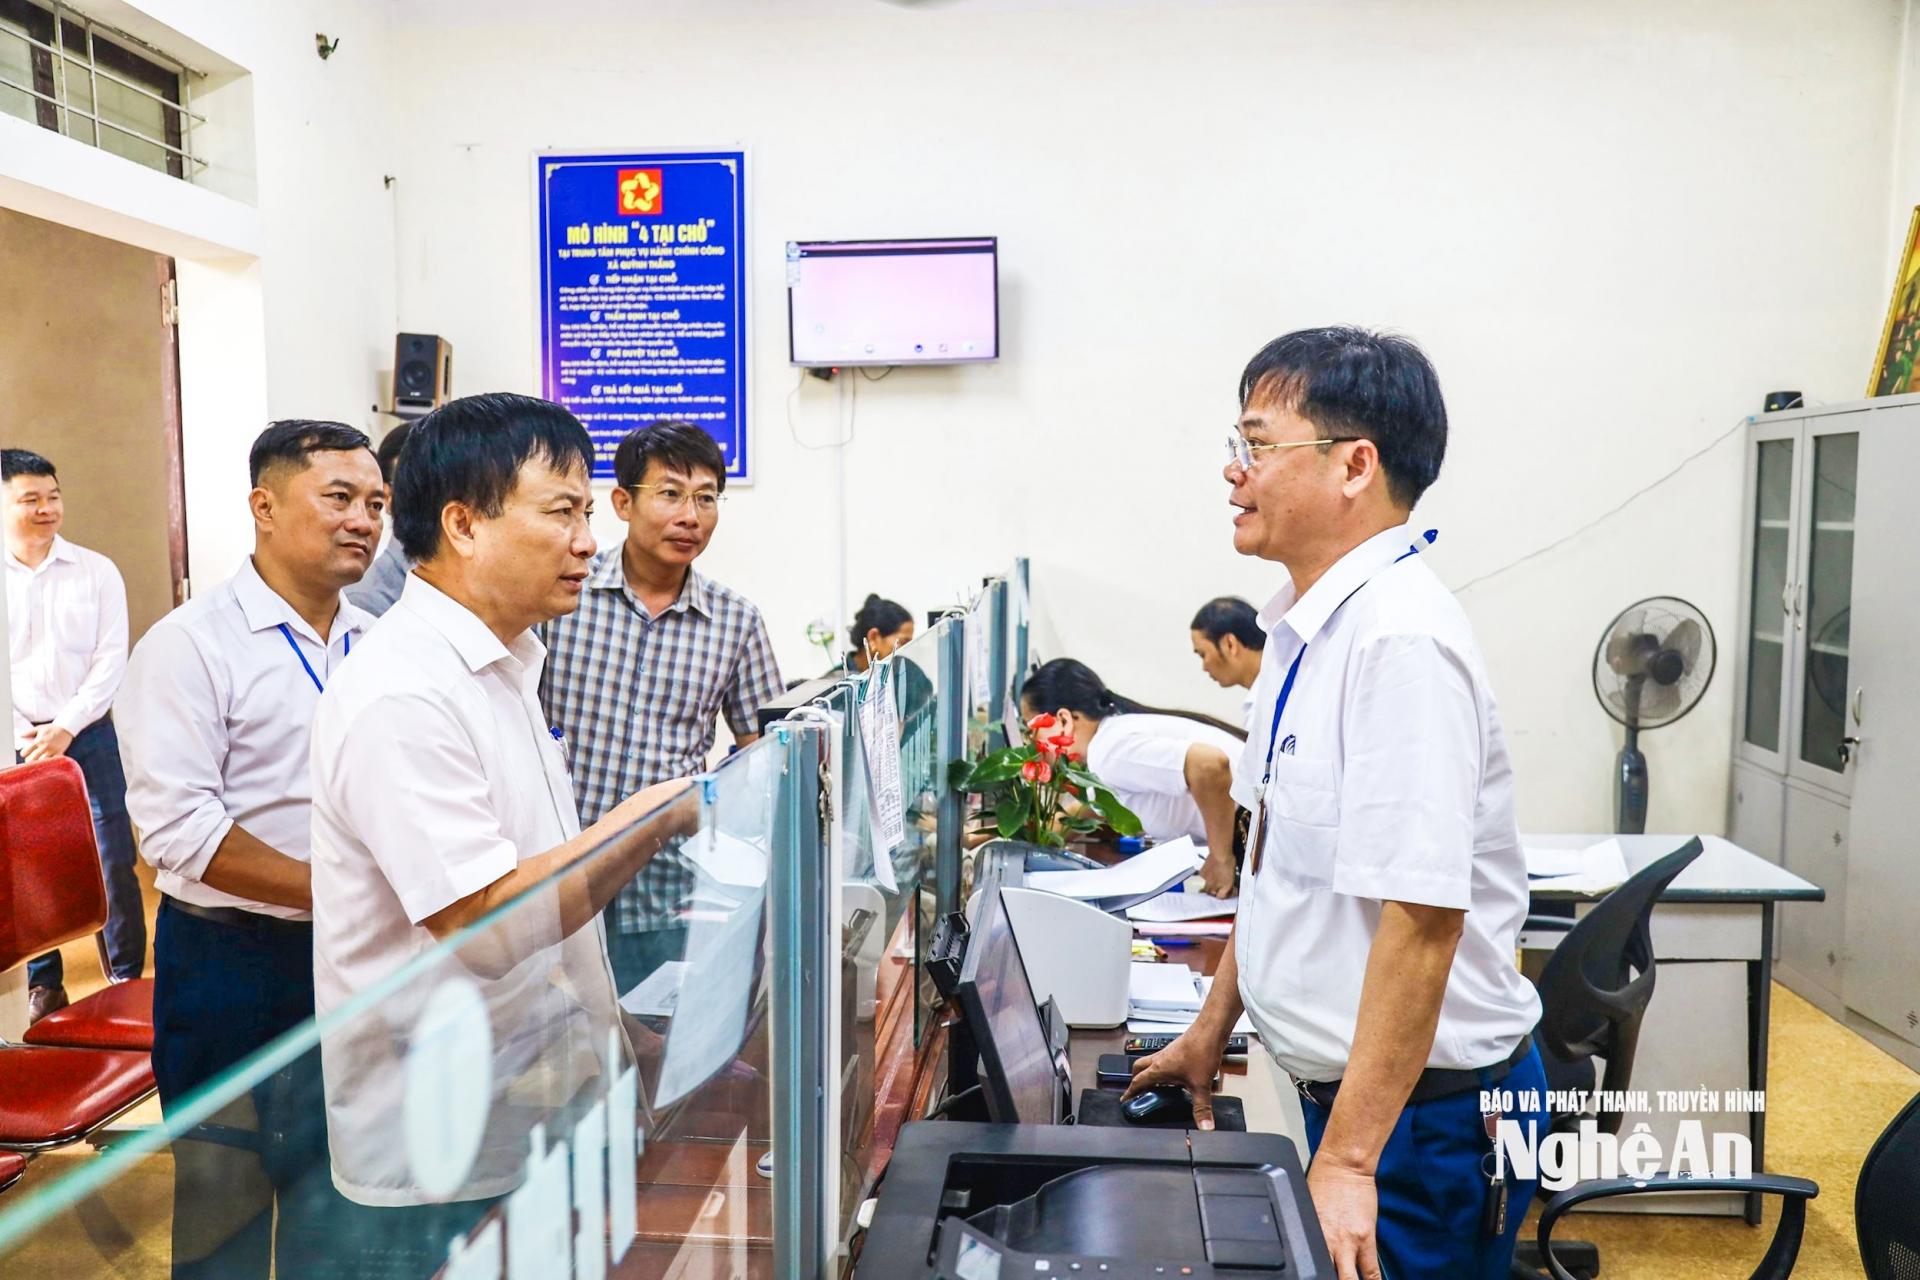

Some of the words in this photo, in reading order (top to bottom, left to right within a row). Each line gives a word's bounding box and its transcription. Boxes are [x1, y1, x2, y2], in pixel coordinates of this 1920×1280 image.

[567, 222, 590, 245] MÔ
[593, 222, 628, 244] HÌNH
[651, 224, 675, 246] TẠI
